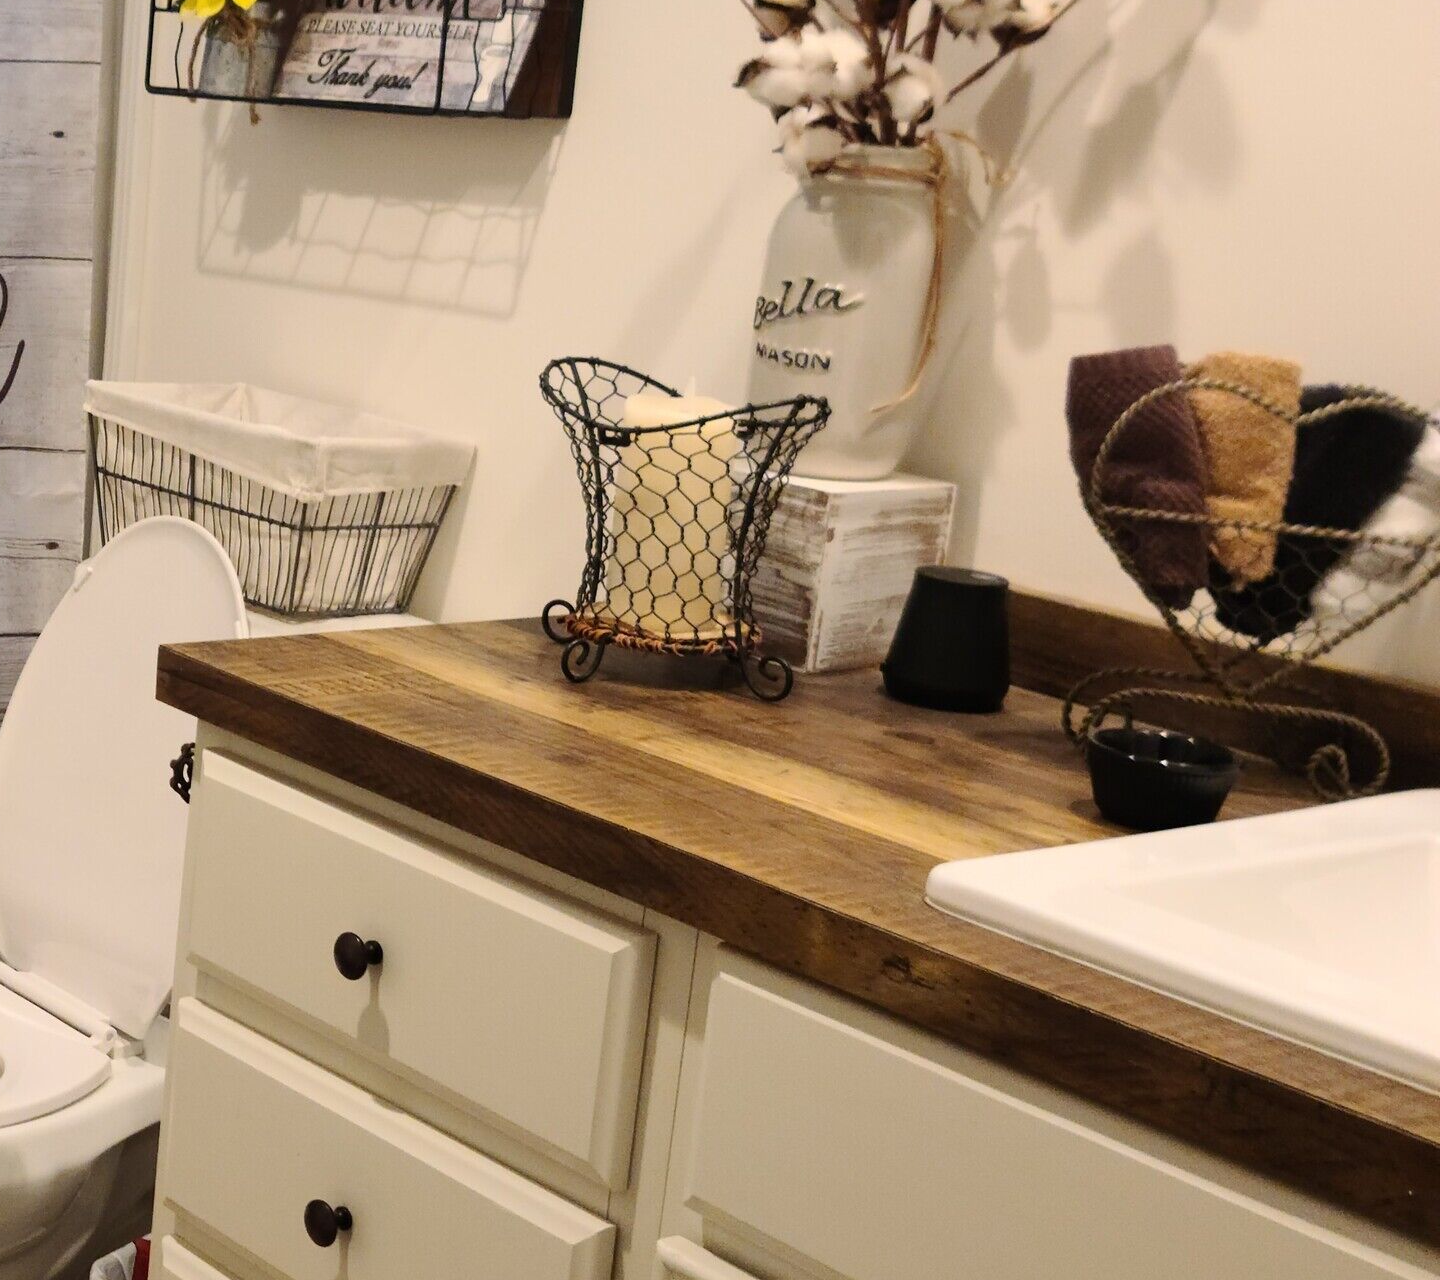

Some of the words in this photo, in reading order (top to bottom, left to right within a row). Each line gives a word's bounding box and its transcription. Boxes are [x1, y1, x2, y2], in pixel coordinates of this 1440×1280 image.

[307, 19, 356, 35] PLEASE
[357, 20, 393, 36] SEAT
[307, 47, 376, 87] Thank
[363, 61, 429, 99] you!
[753, 277, 864, 331] Bella
[756, 341, 832, 372] MASON
